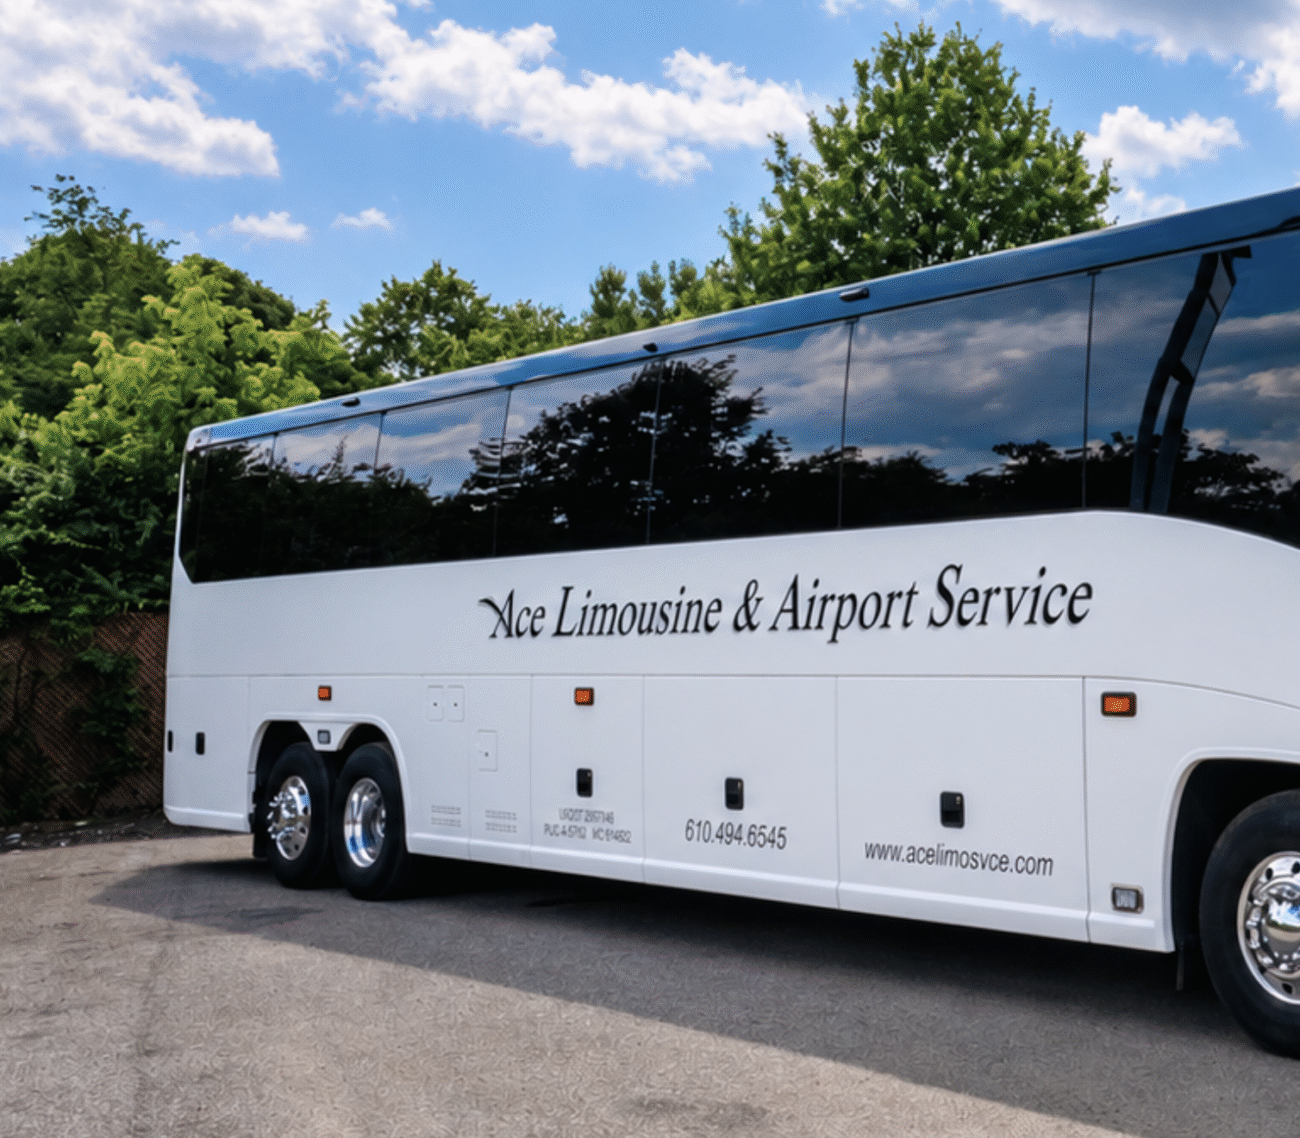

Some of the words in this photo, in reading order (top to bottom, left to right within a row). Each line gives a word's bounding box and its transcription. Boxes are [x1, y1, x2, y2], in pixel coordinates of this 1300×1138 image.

[479, 589, 545, 639] Ace
[552, 585, 721, 637] Limousine
[732, 579, 762, 633] &
[769, 573, 919, 643] Airport
[928, 563, 1094, 628] Service
[685, 819, 788, 850] 610.494.6545
[864, 842, 1054, 876] www.acelimosvce.com
